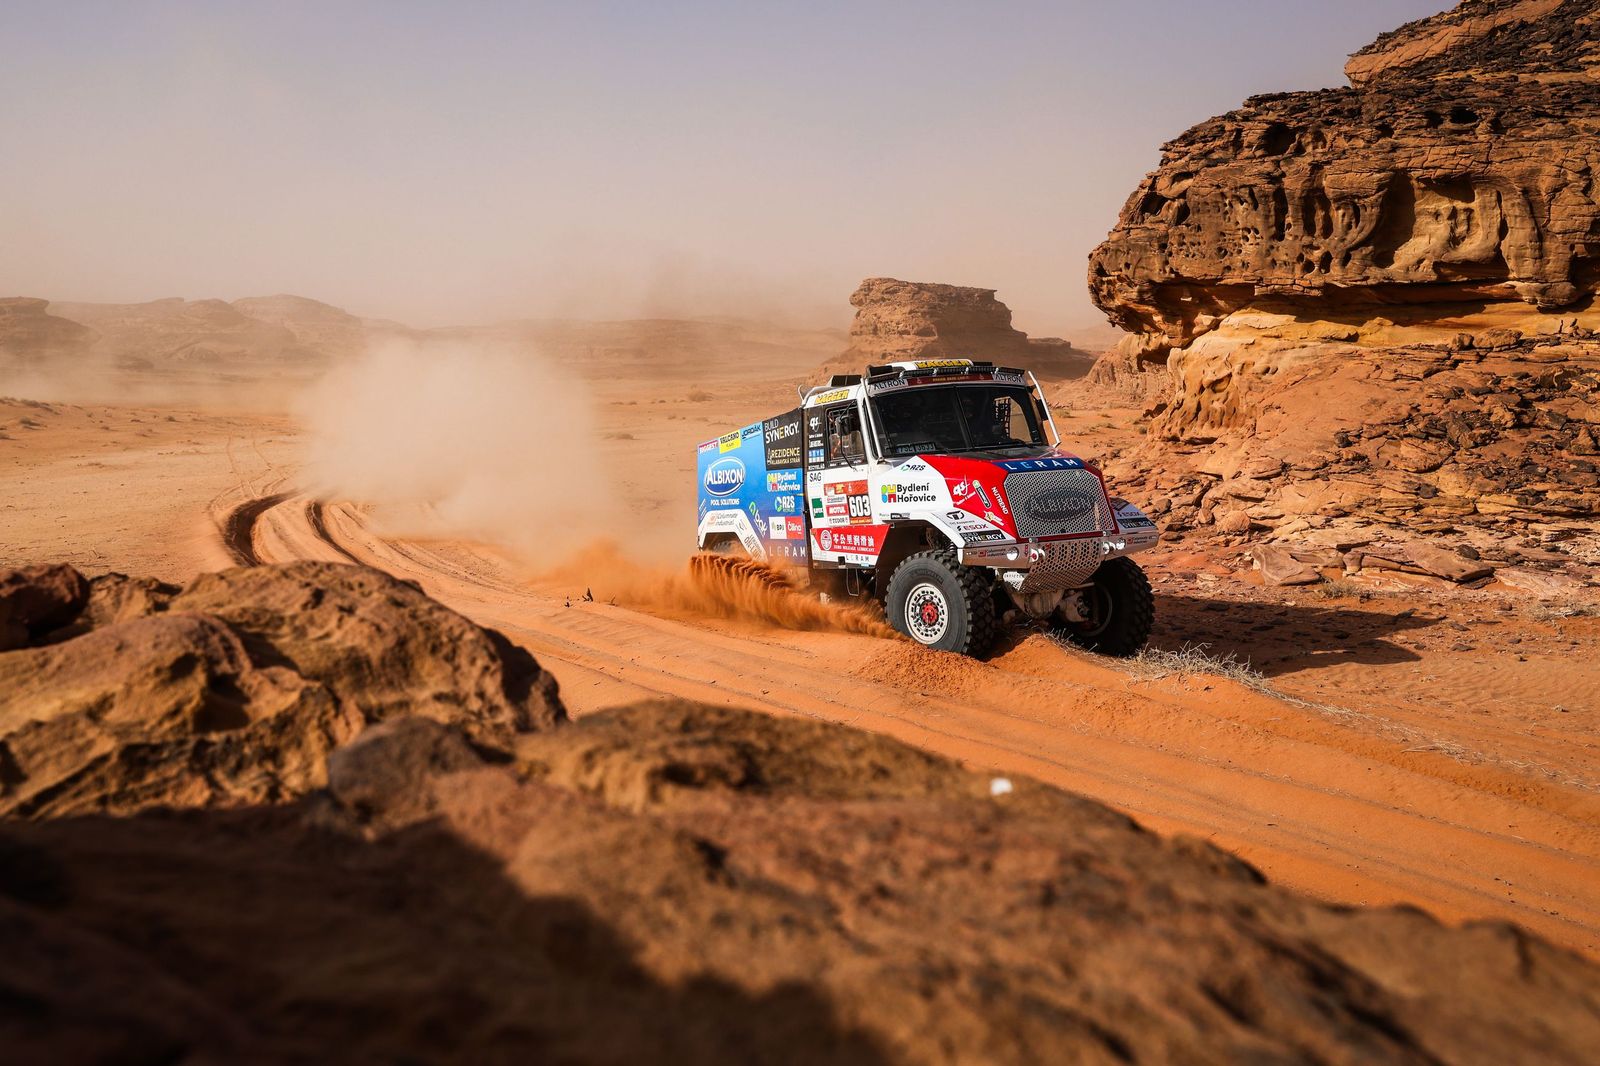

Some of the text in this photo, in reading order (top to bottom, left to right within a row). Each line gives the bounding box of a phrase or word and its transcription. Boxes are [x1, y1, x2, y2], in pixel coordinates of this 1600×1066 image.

[995, 373, 1022, 383] ALTRON
[874, 378, 905, 391] ALTRON
[764, 418, 779, 431] BUILD
[771, 447, 800, 460] REZIDENCE
[706, 465, 743, 485] ALBIXON
[777, 471, 797, 482] Bydlení
[809, 472, 822, 482] SAG
[897, 482, 929, 495] Bydlení
[720, 498, 740, 506] SOLUTIONS
[782, 496, 795, 508] AZS
[897, 494, 937, 504] Hořovice
[991, 487, 1009, 515] NUTREND
[829, 506, 846, 514] MOTUL
[849, 495, 871, 517] 603
[963, 533, 1003, 542] SYNERGY
